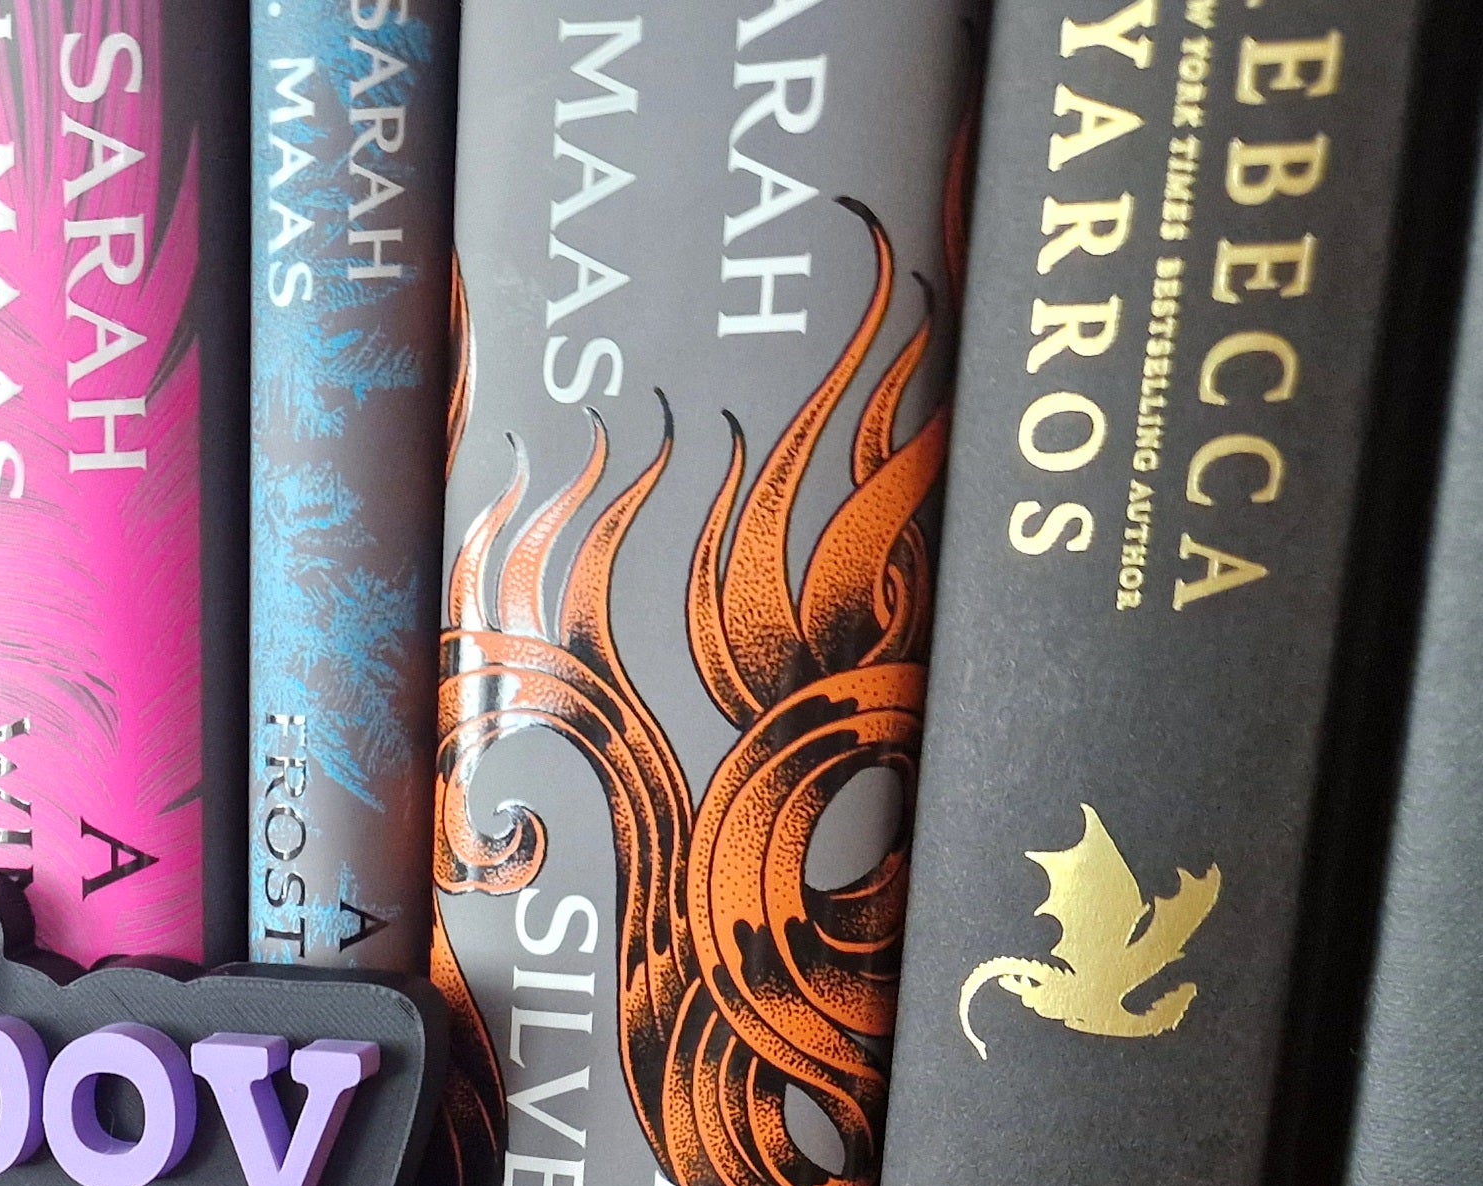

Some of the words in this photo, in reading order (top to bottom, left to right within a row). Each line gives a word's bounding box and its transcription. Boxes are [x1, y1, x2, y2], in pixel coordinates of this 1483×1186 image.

[59, 32, 147, 474] SARAH
[268, 57, 315, 308] MAAS
[347, 0, 409, 281] SARAH
[542, 15, 643, 405] MAAS
[1159, 133, 1202, 241] TIMES
[1008, 0, 1157, 556] YARROS
[1133, 257, 1185, 472] BESTSELLING
[1172, 0, 1345, 612] EBECCA
[1116, 478, 1156, 611] AUTHOR
[80, 816, 160, 901] A
[265, 712, 307, 957] FROST
[339, 898, 390, 953] A
